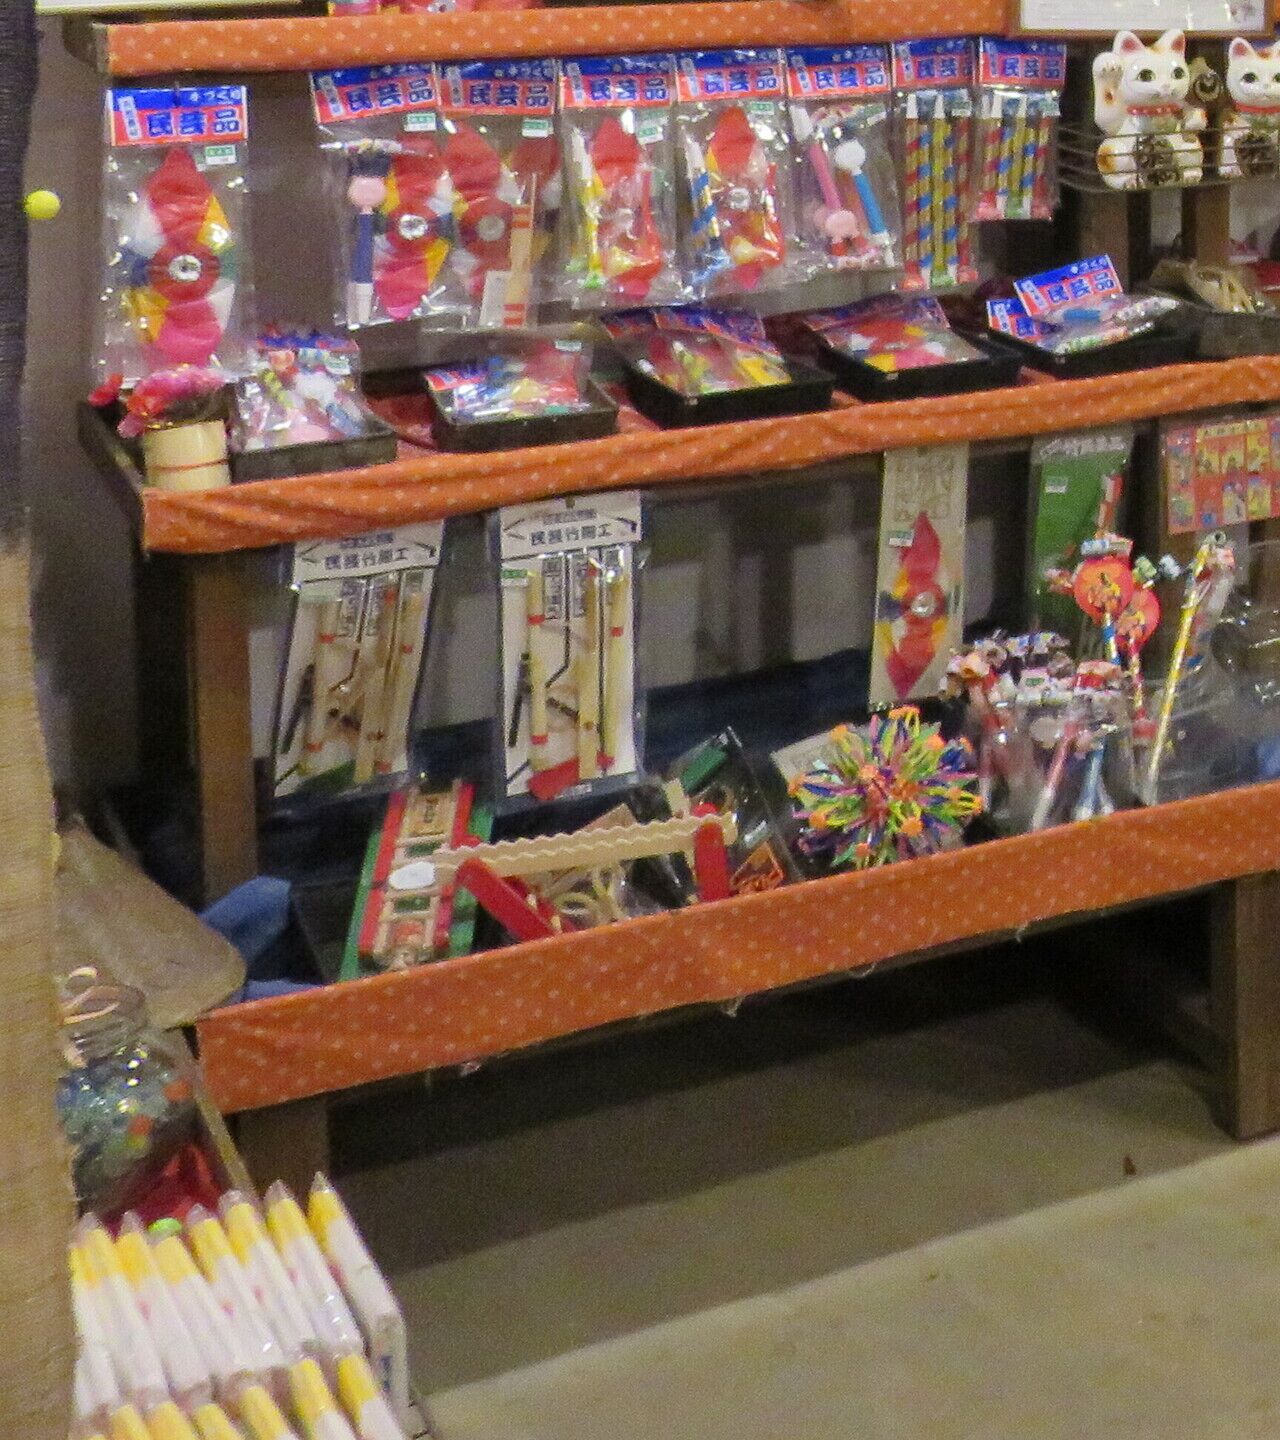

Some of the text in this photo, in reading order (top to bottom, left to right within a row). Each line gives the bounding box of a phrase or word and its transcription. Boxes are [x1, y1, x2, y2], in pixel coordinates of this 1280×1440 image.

[589, 75, 668, 101] 民芸品
[705, 67, 779, 94] 民芸品
[814, 65, 888, 90] 民芸品
[346, 78, 436, 110] 民芸品
[468, 82, 553, 107] 民芸品
[147, 109, 240, 137] 民芸品
[1047, 270, 1115, 303] 民芸品
